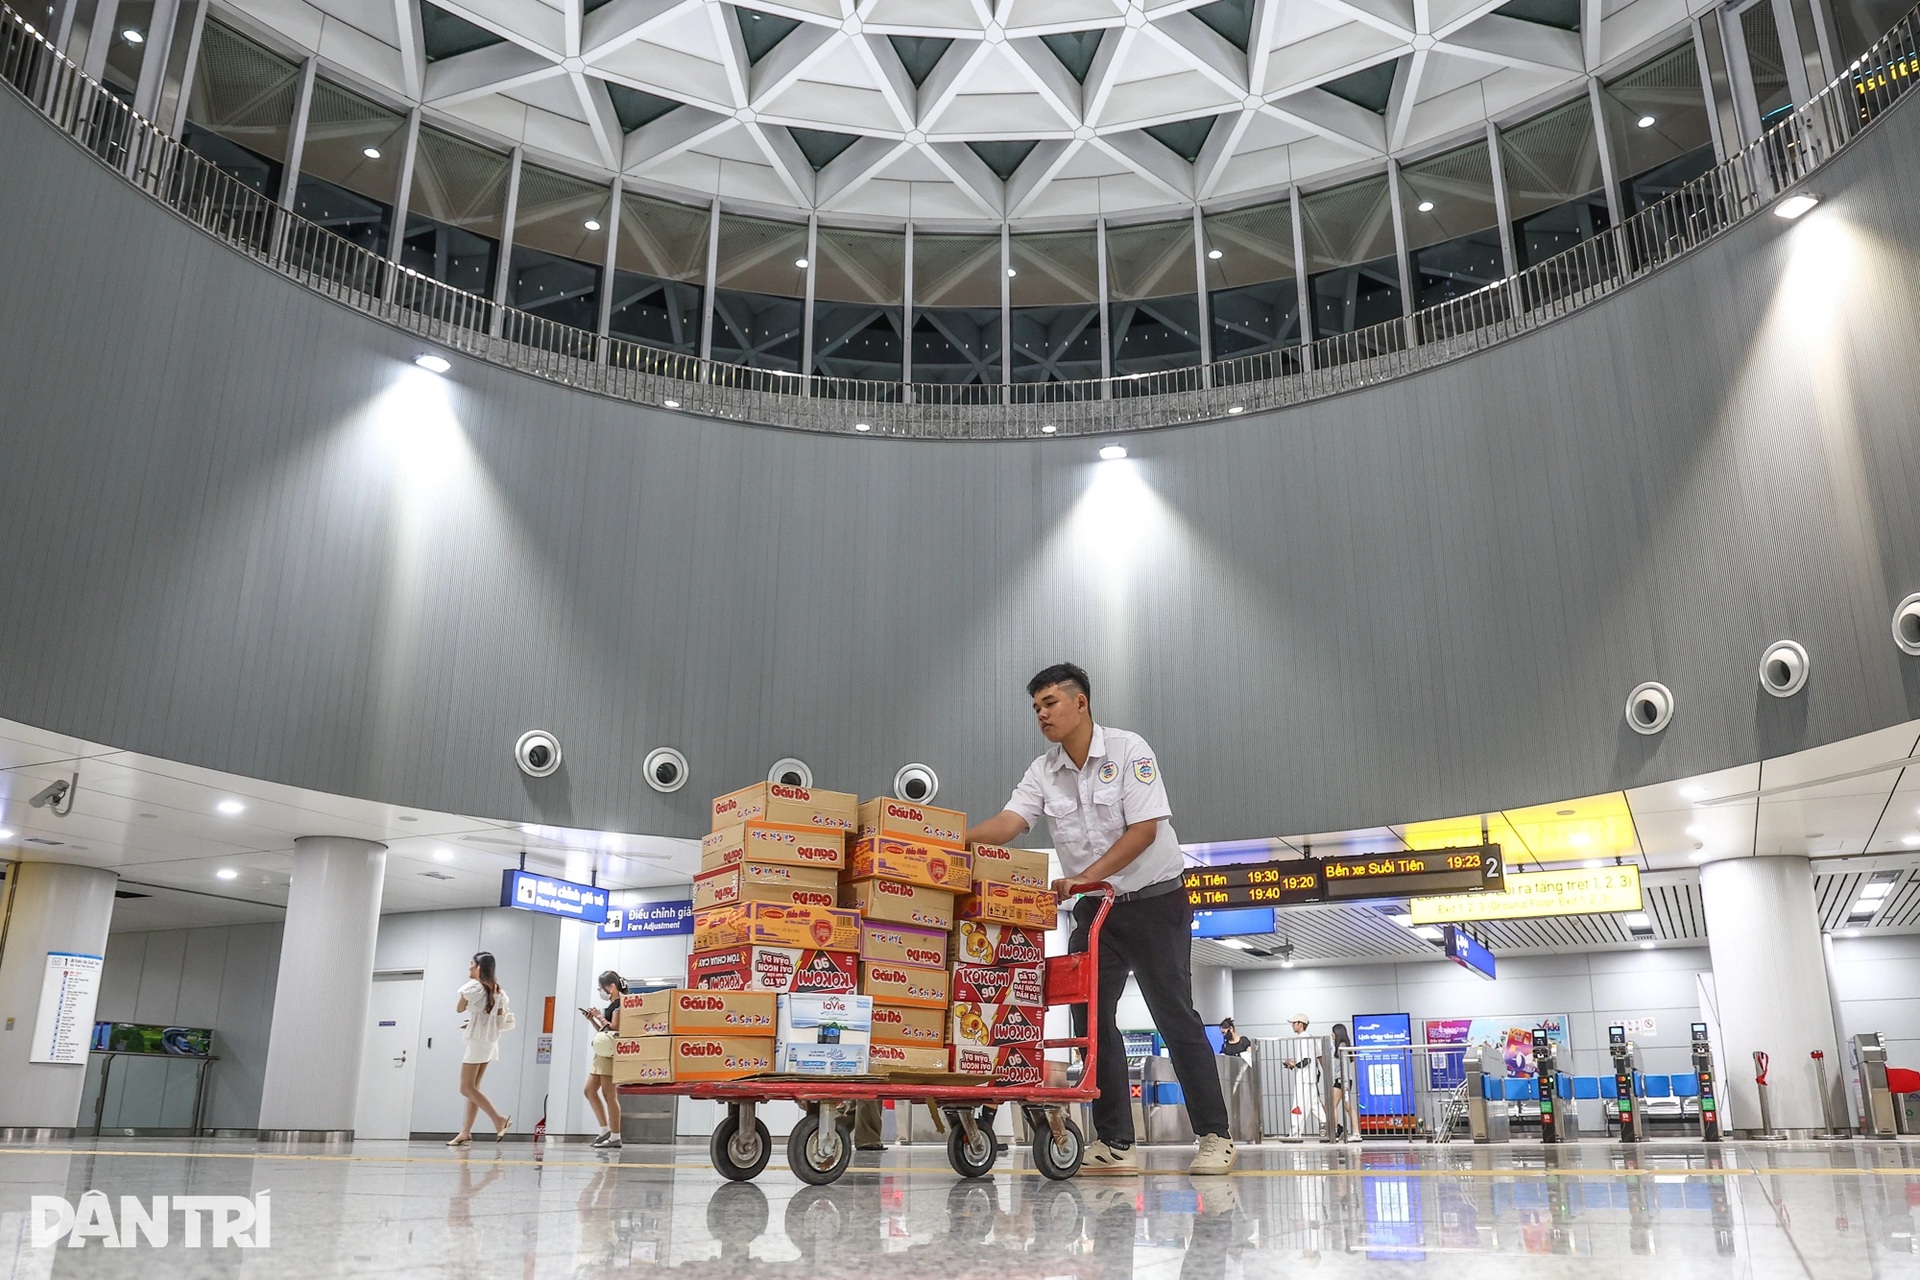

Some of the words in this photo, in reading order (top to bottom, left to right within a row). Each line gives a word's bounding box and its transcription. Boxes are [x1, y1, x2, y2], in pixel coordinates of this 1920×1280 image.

[1325, 863, 1349, 878] Bến
[1352, 866, 1365, 875] xe
[1368, 860, 1395, 874] Suối
[1398, 860, 1425, 872] Tiên
[1447, 855, 1480, 868] 19:23
[1485, 857, 1499, 878] 2
[1203, 875, 1227, 886] Tiên
[1247, 870, 1279, 883] 19:30
[1283, 876, 1314, 889] 19:20
[1204, 892, 1228, 903] Tiên
[1249, 887, 1280, 900] 19:40
[1518, 884, 1532, 894] ra
[629, 908, 649, 920] Điều
[651, 907, 675, 918] chỉnh
[678, 906, 691, 919] giá
[627, 923, 642, 931] Fare
[643, 921, 680, 931] Adjustment
[998, 943, 1043, 962] KOKOMI
[813, 956, 830, 969] 90
[797, 969, 852, 989] KOKOMI
[960, 968, 1010, 987] KOKOMI
[981, 986, 995, 998] 90
[1008, 1013, 1022, 1024] 90
[994, 1024, 1041, 1040] KOKOMI
[1008, 1054, 1022, 1065] 90
